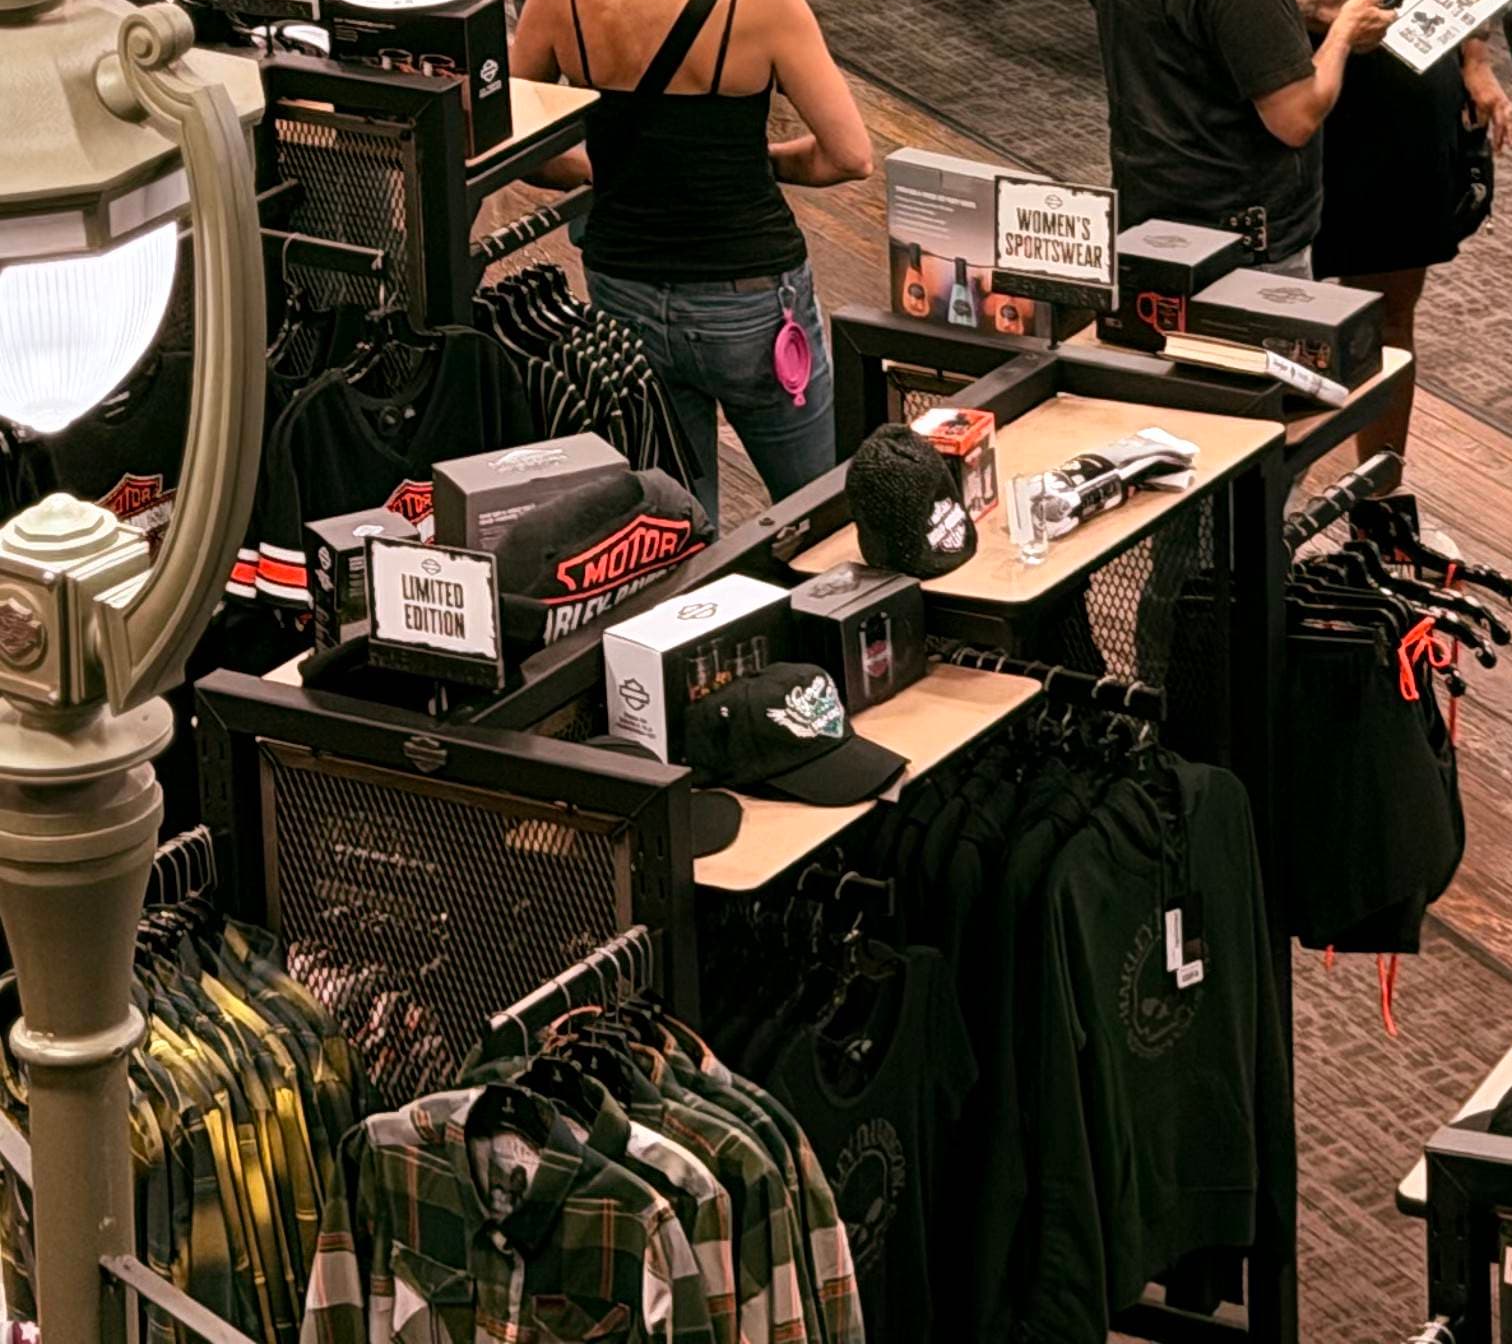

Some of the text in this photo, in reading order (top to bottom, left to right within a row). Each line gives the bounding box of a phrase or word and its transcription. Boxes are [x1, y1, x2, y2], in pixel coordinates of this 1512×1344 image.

[1016, 208, 1091, 241] WOMEN'S
[1005, 232, 1103, 269] SPORTSWEAR
[582, 526, 680, 589] MOTOR
[401, 573, 464, 610] LIMITED
[404, 604, 466, 640] EDITION
